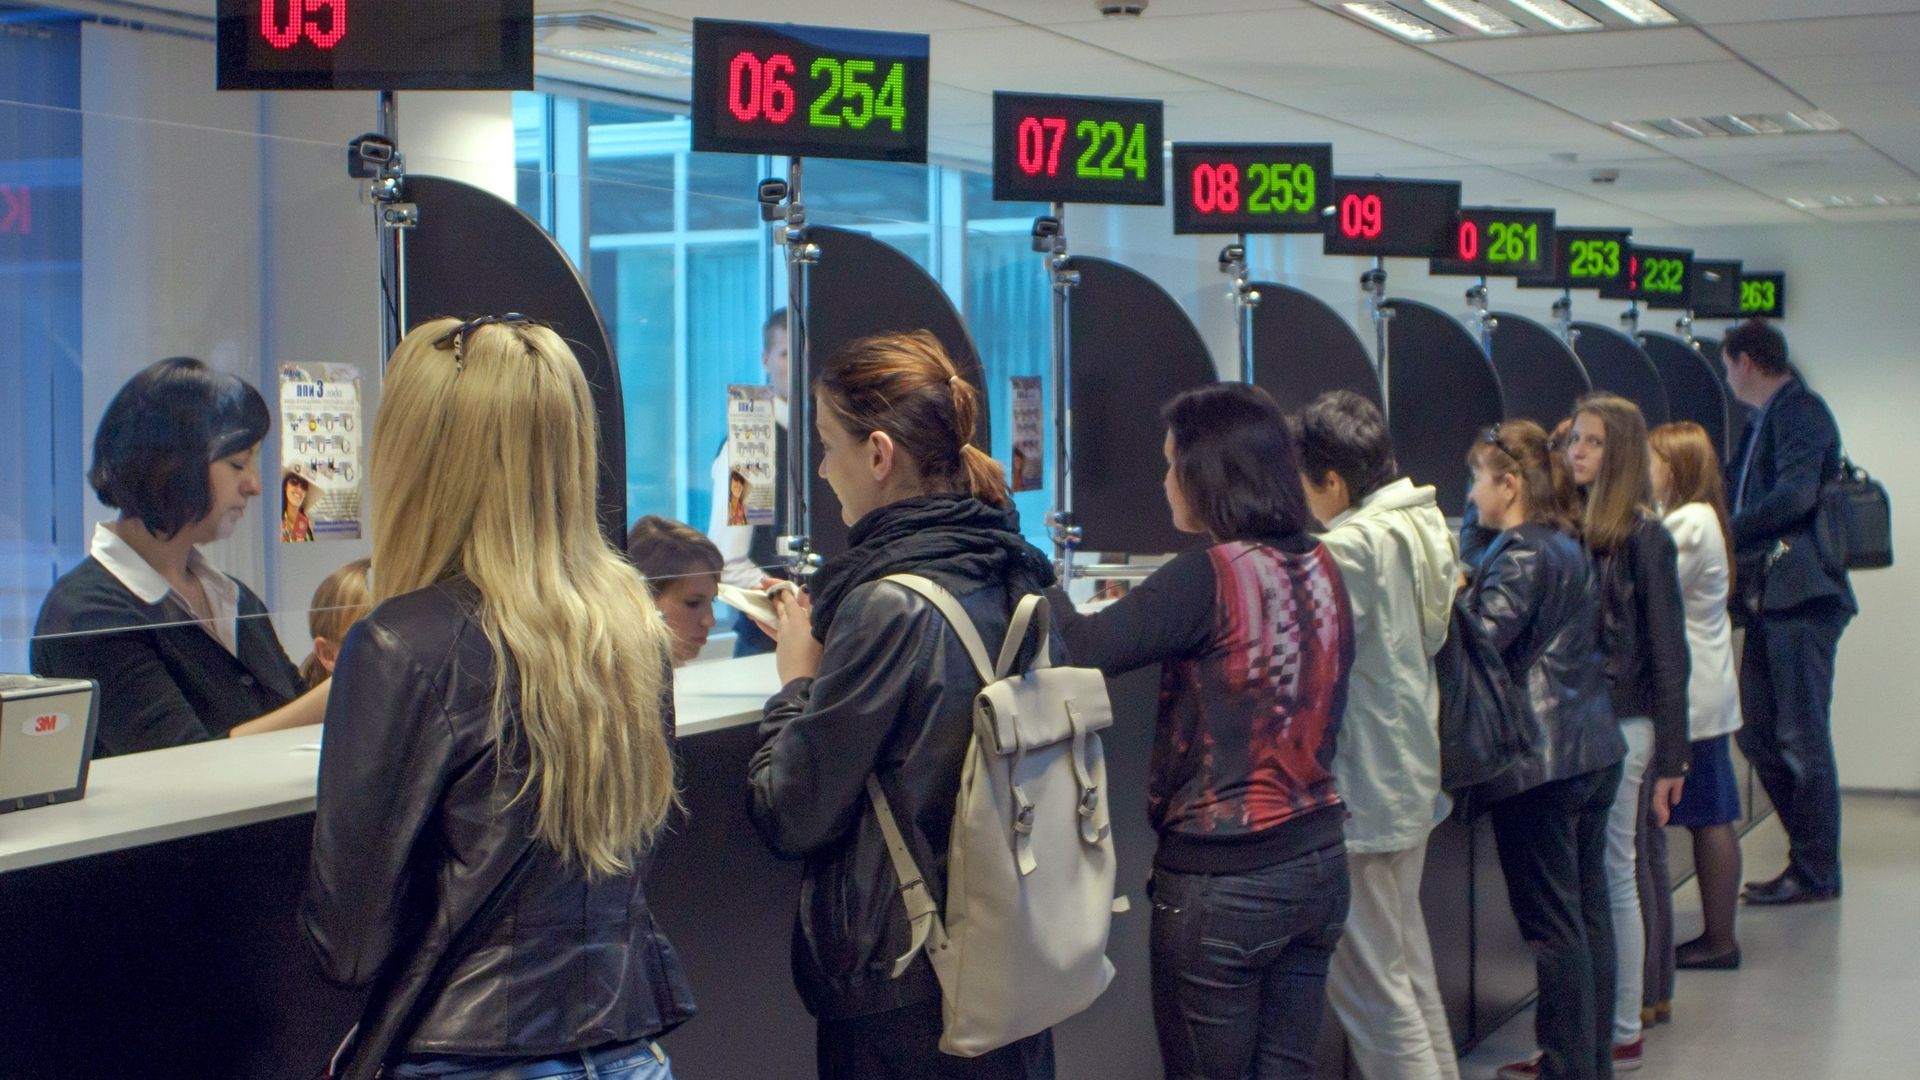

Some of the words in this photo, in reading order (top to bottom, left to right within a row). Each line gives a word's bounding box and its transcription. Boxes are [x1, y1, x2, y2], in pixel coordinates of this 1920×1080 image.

[261, 0, 346, 49] 05
[728, 51, 796, 124] 06
[808, 57, 907, 132] 254
[1017, 116, 1068, 176] 07
[1075, 119, 1148, 181] 224
[1192, 163, 1240, 214] 08
[1247, 163, 1316, 214] 259
[1341, 194, 1383, 239] 09
[1458, 221, 1478, 262] 0
[1487, 222, 1538, 263] 261
[1569, 240, 1620, 278] 253
[1642, 257, 1684, 293] 232
[1740, 280, 1775, 311] 263
[35, 715, 57, 733] 3M
